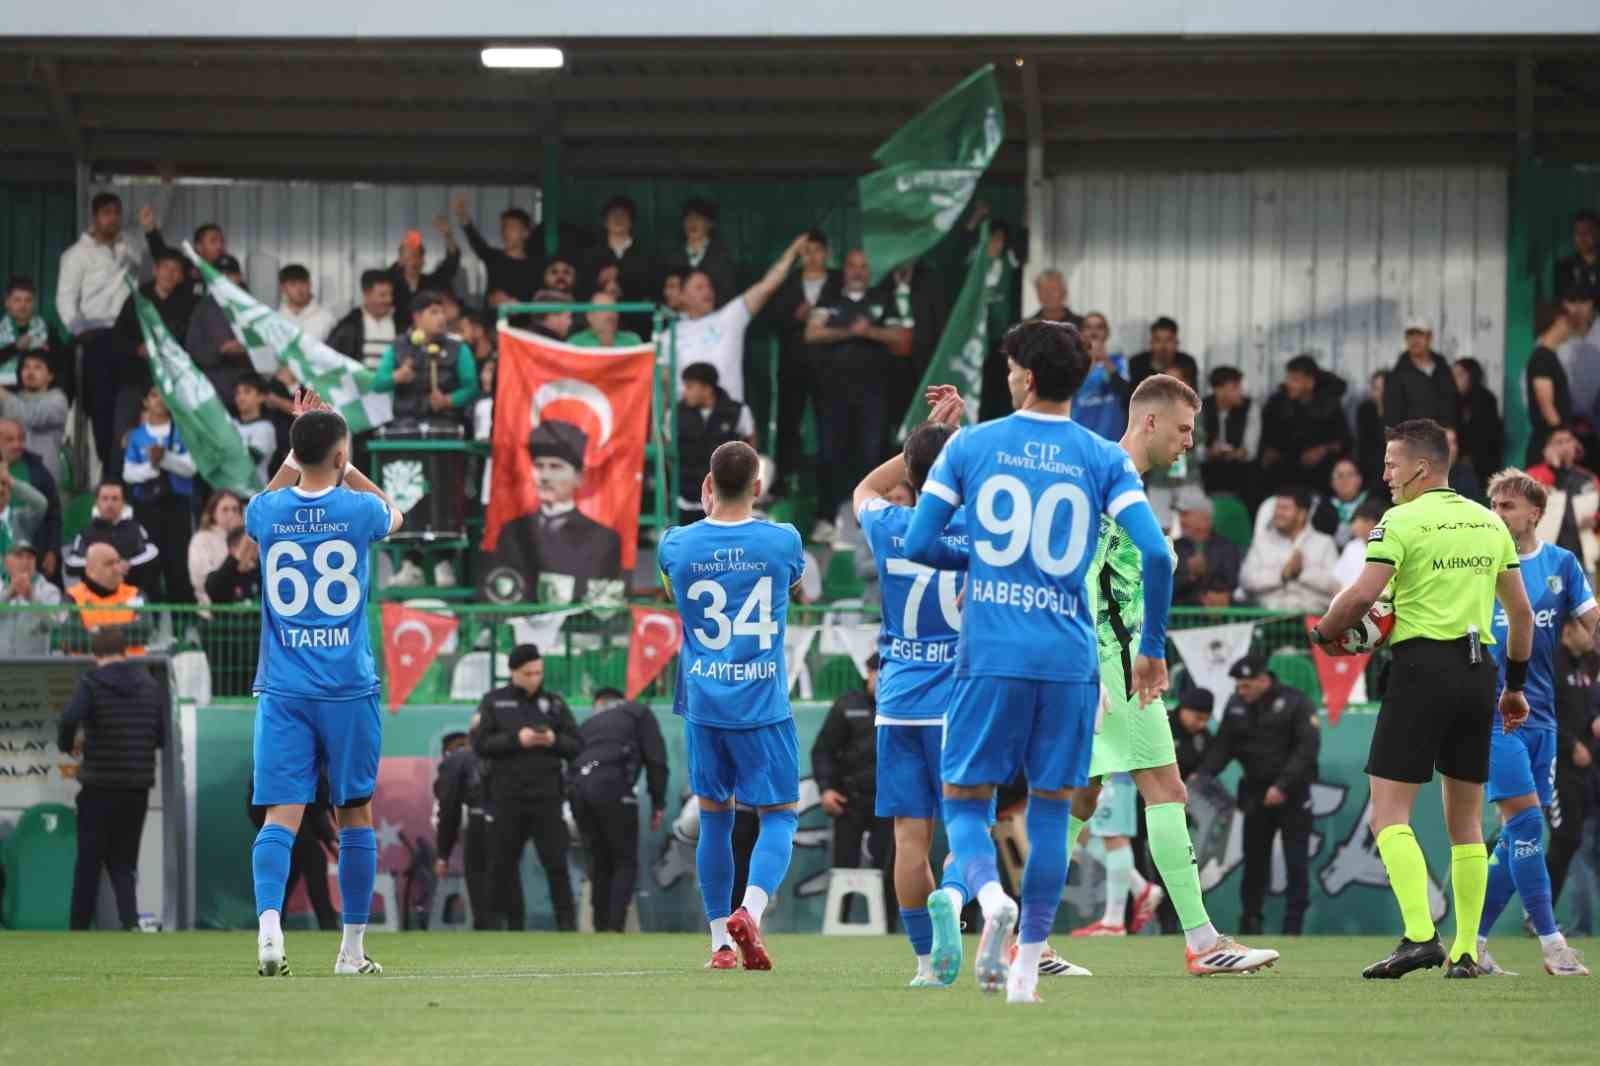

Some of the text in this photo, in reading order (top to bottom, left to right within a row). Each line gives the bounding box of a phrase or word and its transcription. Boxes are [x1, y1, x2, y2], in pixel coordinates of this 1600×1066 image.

[1024, 441, 1061, 461] CIP
[996, 452, 1085, 478] TRAVEL AGENCY
[295, 508, 326, 523] CIP
[974, 474, 1090, 577] 90
[272, 522, 350, 534] TRAVEL AGENCY
[713, 548, 745, 562] CIP
[266, 540, 361, 617] 68
[691, 561, 769, 573] TRAVEL AGENCY
[972, 579, 1079, 618] HABEŞOĞLU
[687, 576, 778, 650] 34
[891, 638, 922, 661] EGE
[689, 658, 777, 681] A.AYTEMUR
